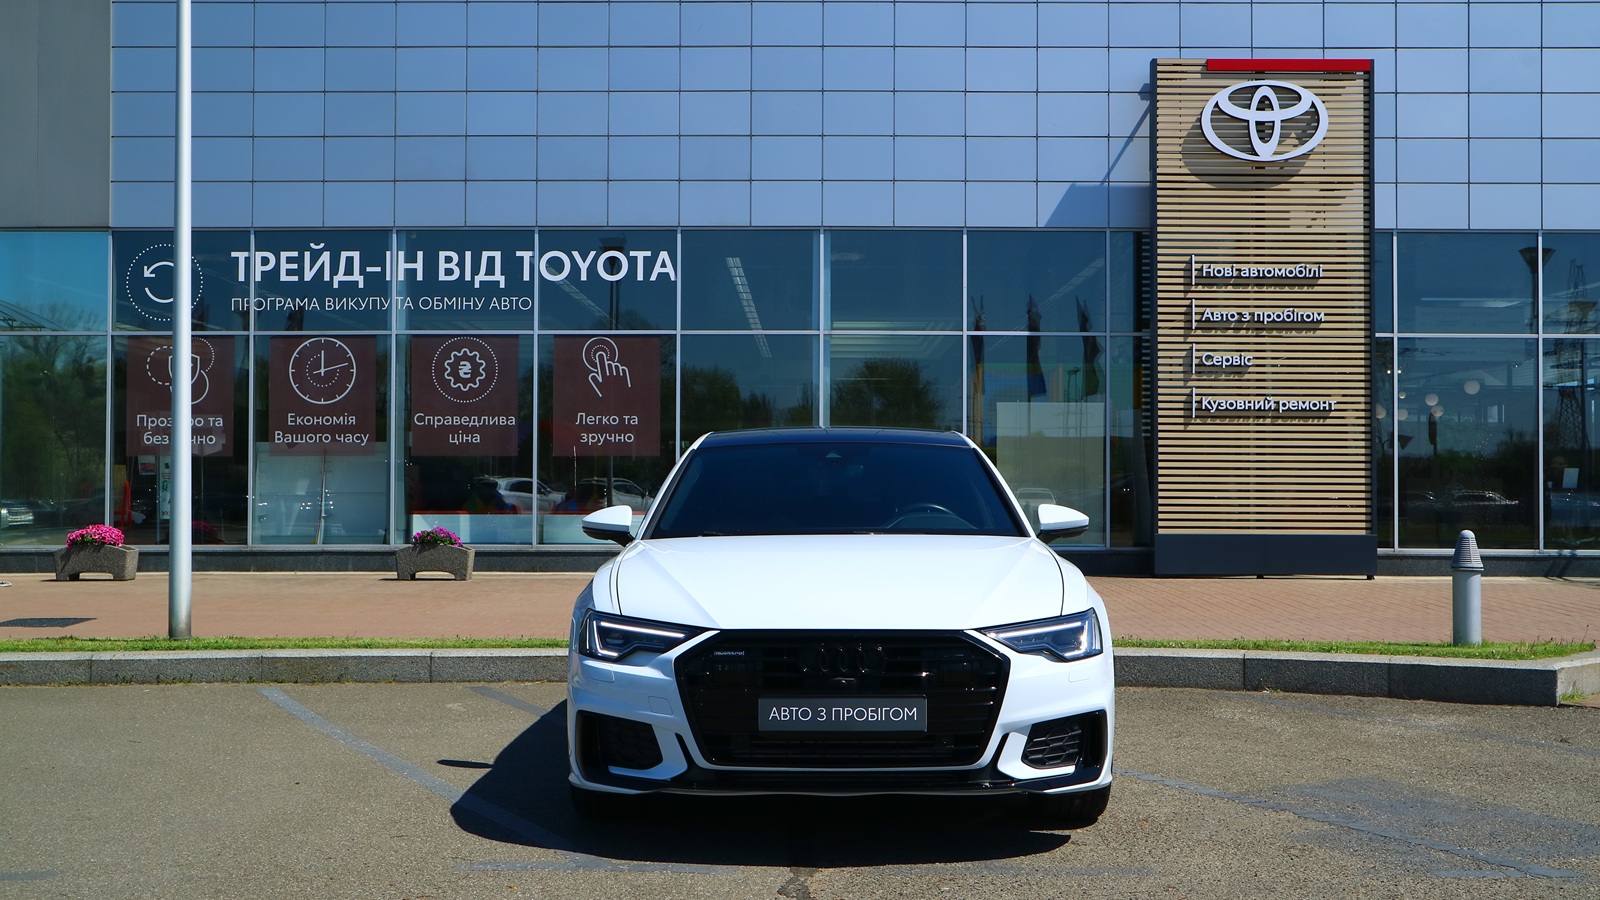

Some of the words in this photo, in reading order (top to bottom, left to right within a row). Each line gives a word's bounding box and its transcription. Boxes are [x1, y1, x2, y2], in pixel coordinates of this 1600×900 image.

[231, 242, 424, 289] ТРЕЙД-ІН
[438, 250, 505, 289] ВІД
[515, 250, 678, 282] TOYOTA
[1202, 263, 1236, 277] Нові
[1240, 263, 1323, 278] автомобілі
[231, 297, 320, 311] ПРОГРАМА
[325, 296, 391, 311] ВИКУПУ
[394, 296, 414, 310] ТА
[418, 296, 485, 311] ОБМІНУ
[489, 296, 532, 311] АВТО
[1202, 308, 1238, 322] Авто
[1241, 311, 1250, 322] з
[1254, 308, 1325, 325] пробігом
[1202, 351, 1254, 369] Сервіс
[1202, 396, 1274, 413] Кузовний
[1279, 399, 1338, 413] ремонт
[208, 417, 224, 427] та
[287, 412, 356, 426] Економія
[413, 412, 516, 428] Справедлива
[575, 412, 620, 425] Легко
[622, 415, 639, 425] та
[274, 430, 332, 443] Вашого
[335, 433, 369, 446] часу
[449, 430, 481, 445] ціна
[580, 433, 635, 446] зручно
[769, 706, 812, 721] АВТО
[832, 706, 917, 721] ПРОБІГОМ
